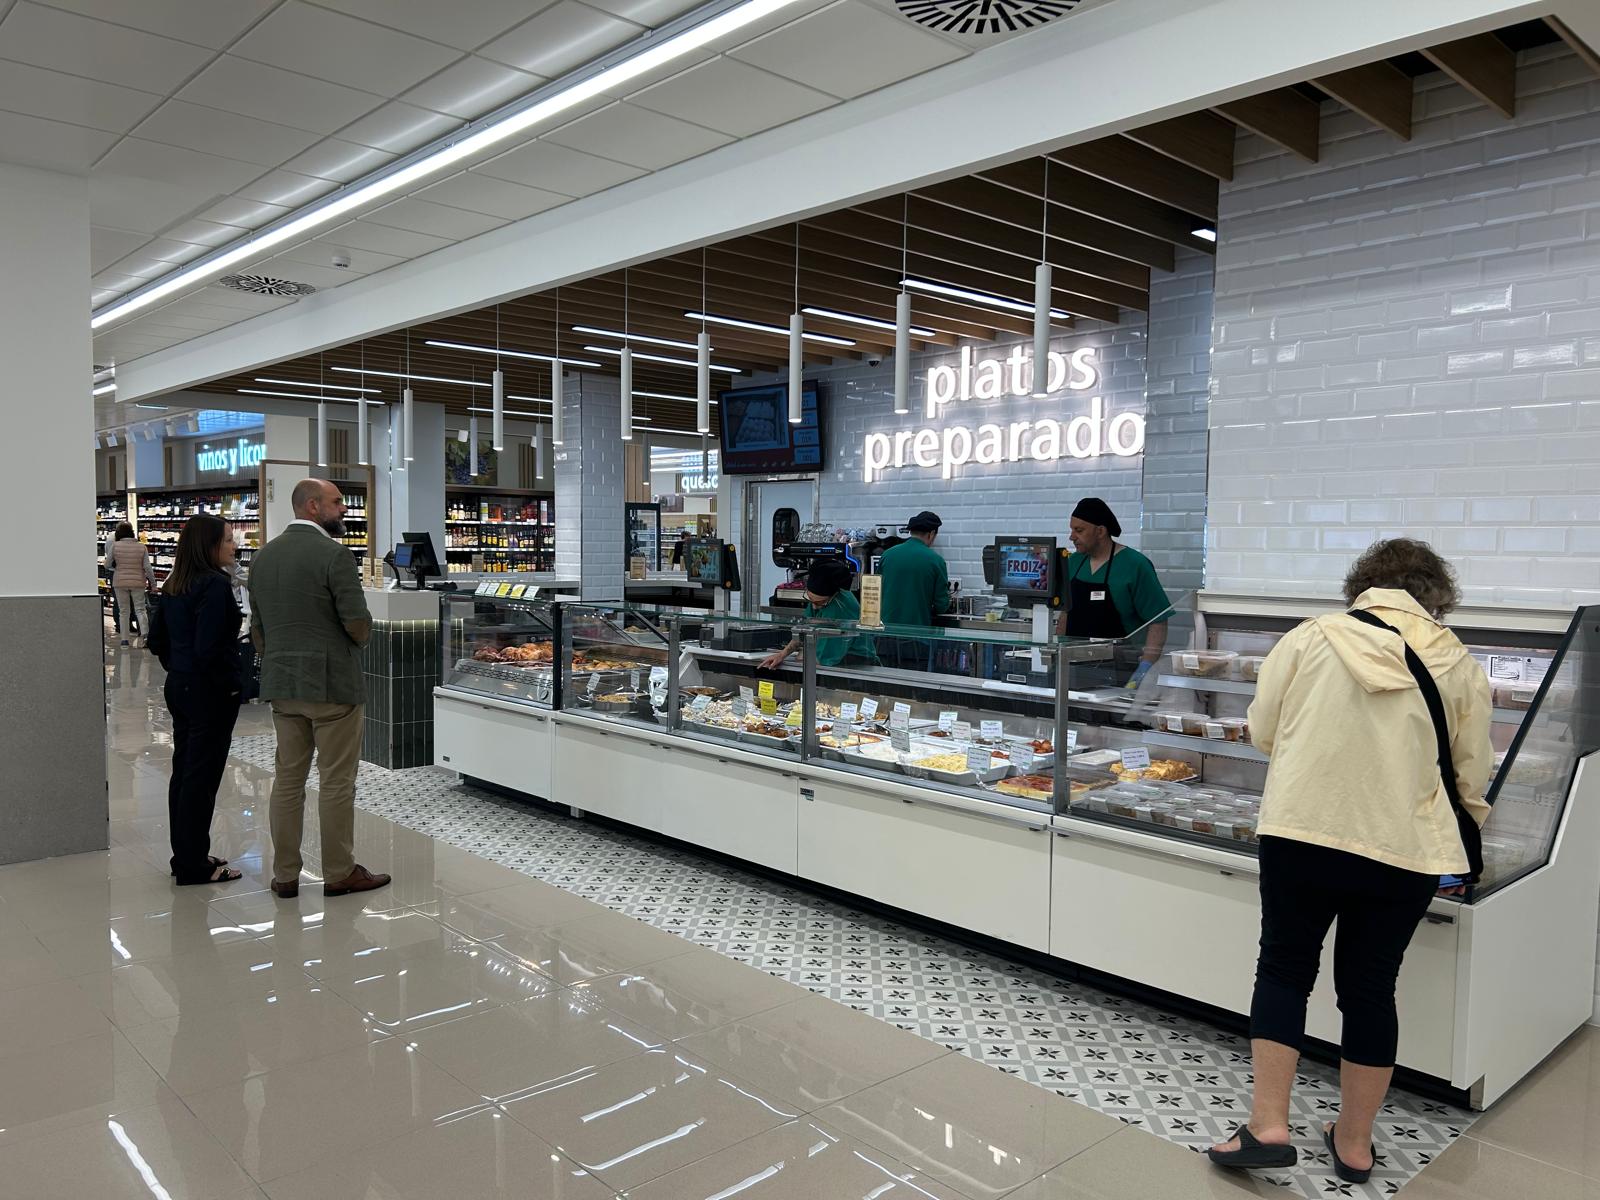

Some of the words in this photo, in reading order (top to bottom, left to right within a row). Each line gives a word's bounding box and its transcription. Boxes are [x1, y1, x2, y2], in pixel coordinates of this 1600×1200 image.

[198, 444, 227, 471] vinos
[228, 448, 238, 475] y
[1007, 559, 1041, 573] FROIZ
